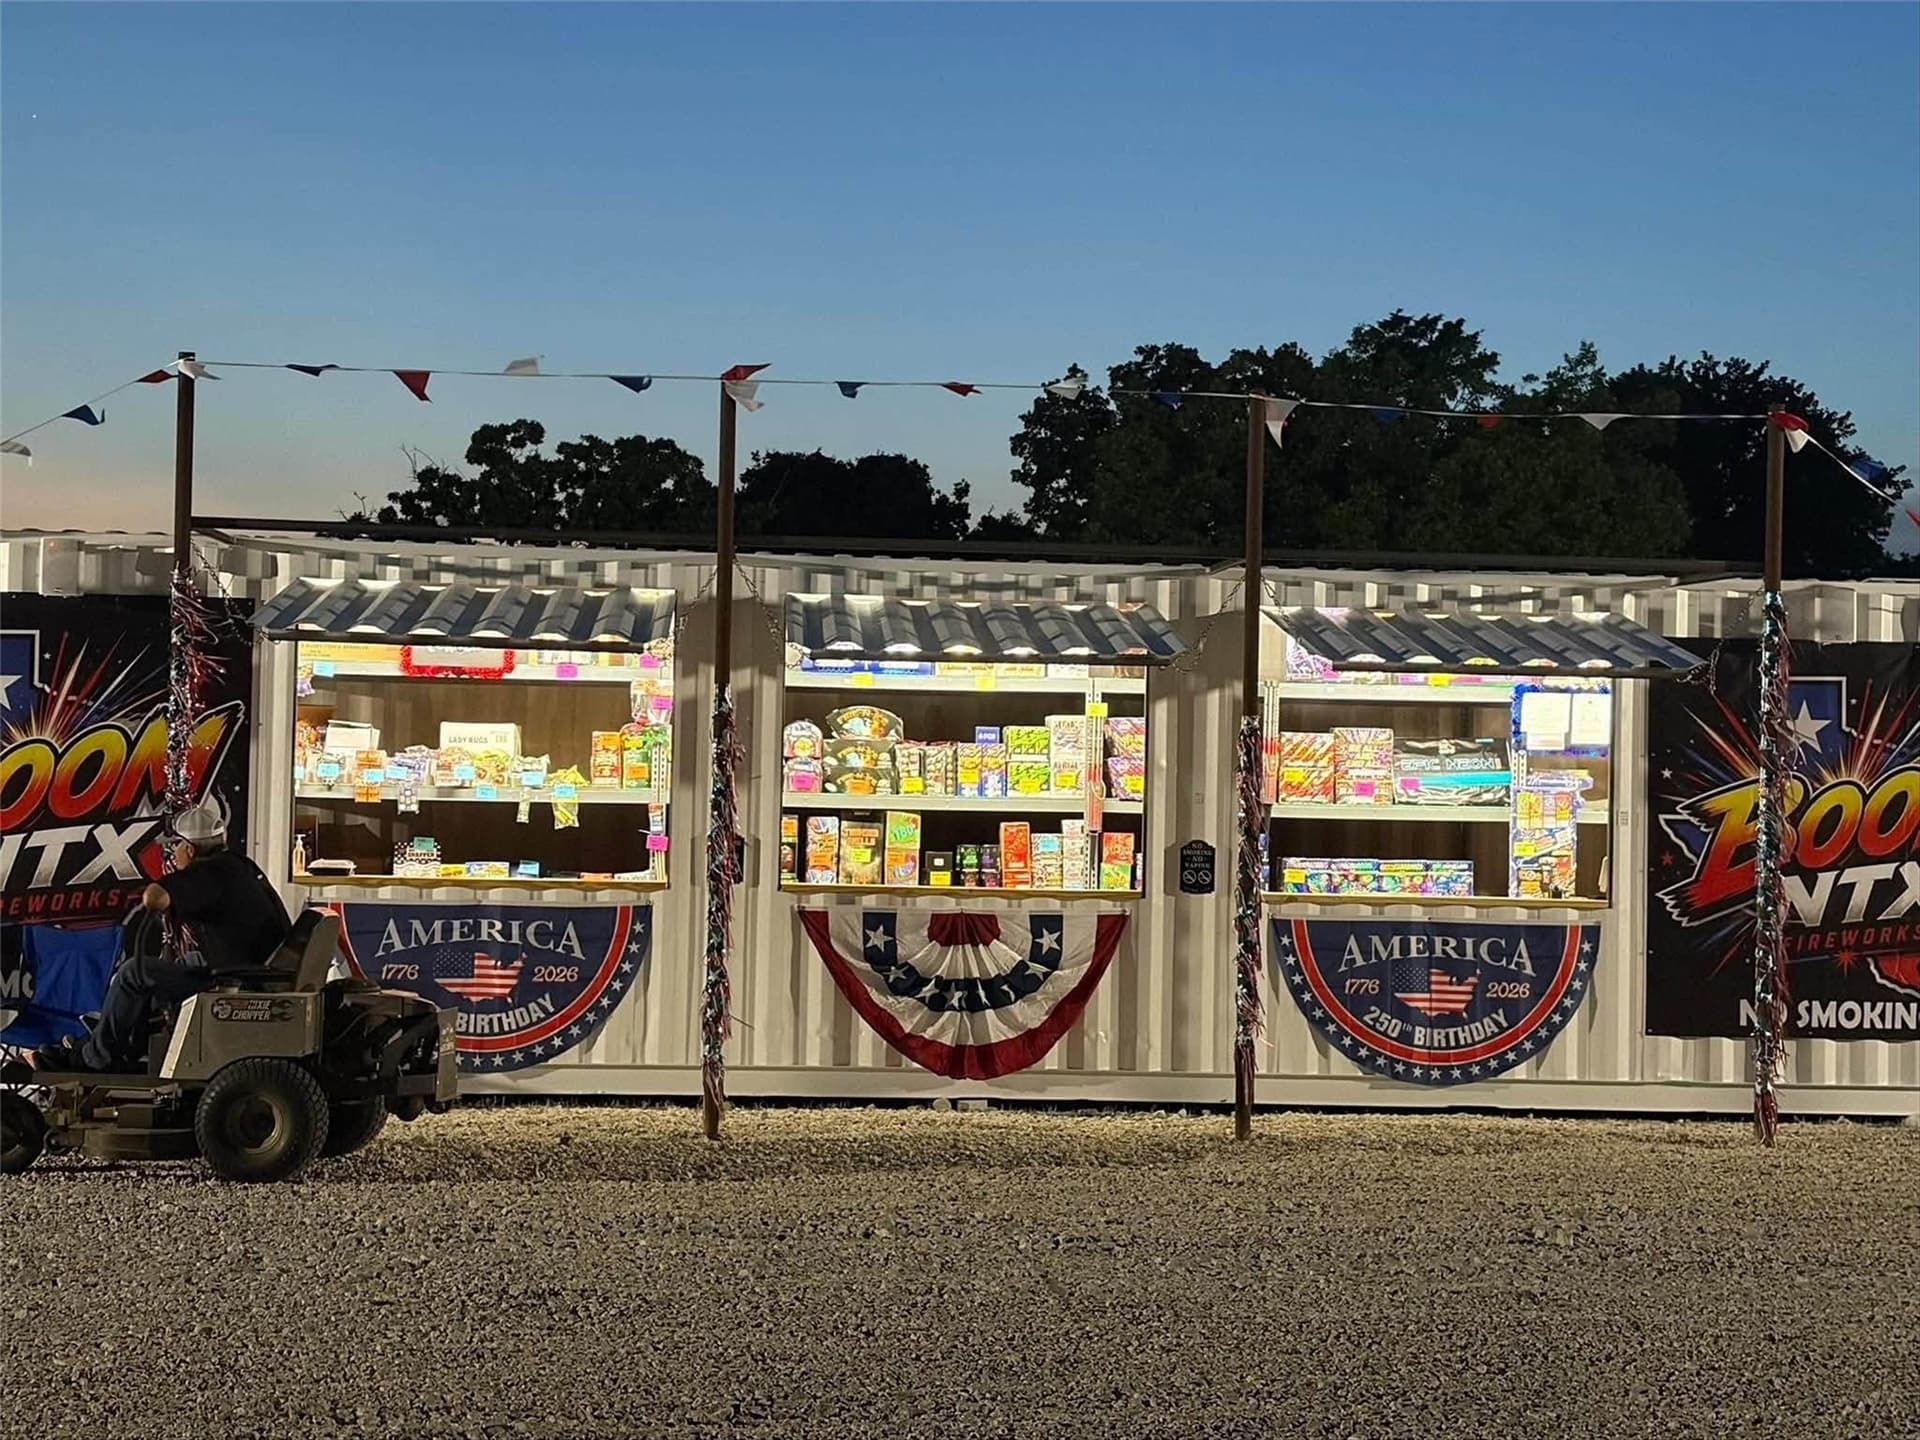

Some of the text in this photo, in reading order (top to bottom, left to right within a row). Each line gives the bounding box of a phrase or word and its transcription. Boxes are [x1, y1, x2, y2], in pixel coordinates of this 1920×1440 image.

[1680, 766, 1920, 912] BOO
[0, 888, 121, 917] EWORKS
[374, 917, 586, 961] AMERICA
[1337, 933, 1537, 977] AMERICA
[381, 963, 580, 984] 1776 2026
[1344, 977, 1531, 999] 1776 2026
[455, 992, 557, 1034] BIRTHDAY
[1413, 1007, 1509, 1048] BIRTHDAY
[1739, 999, 1920, 1030] N SMOKIN
